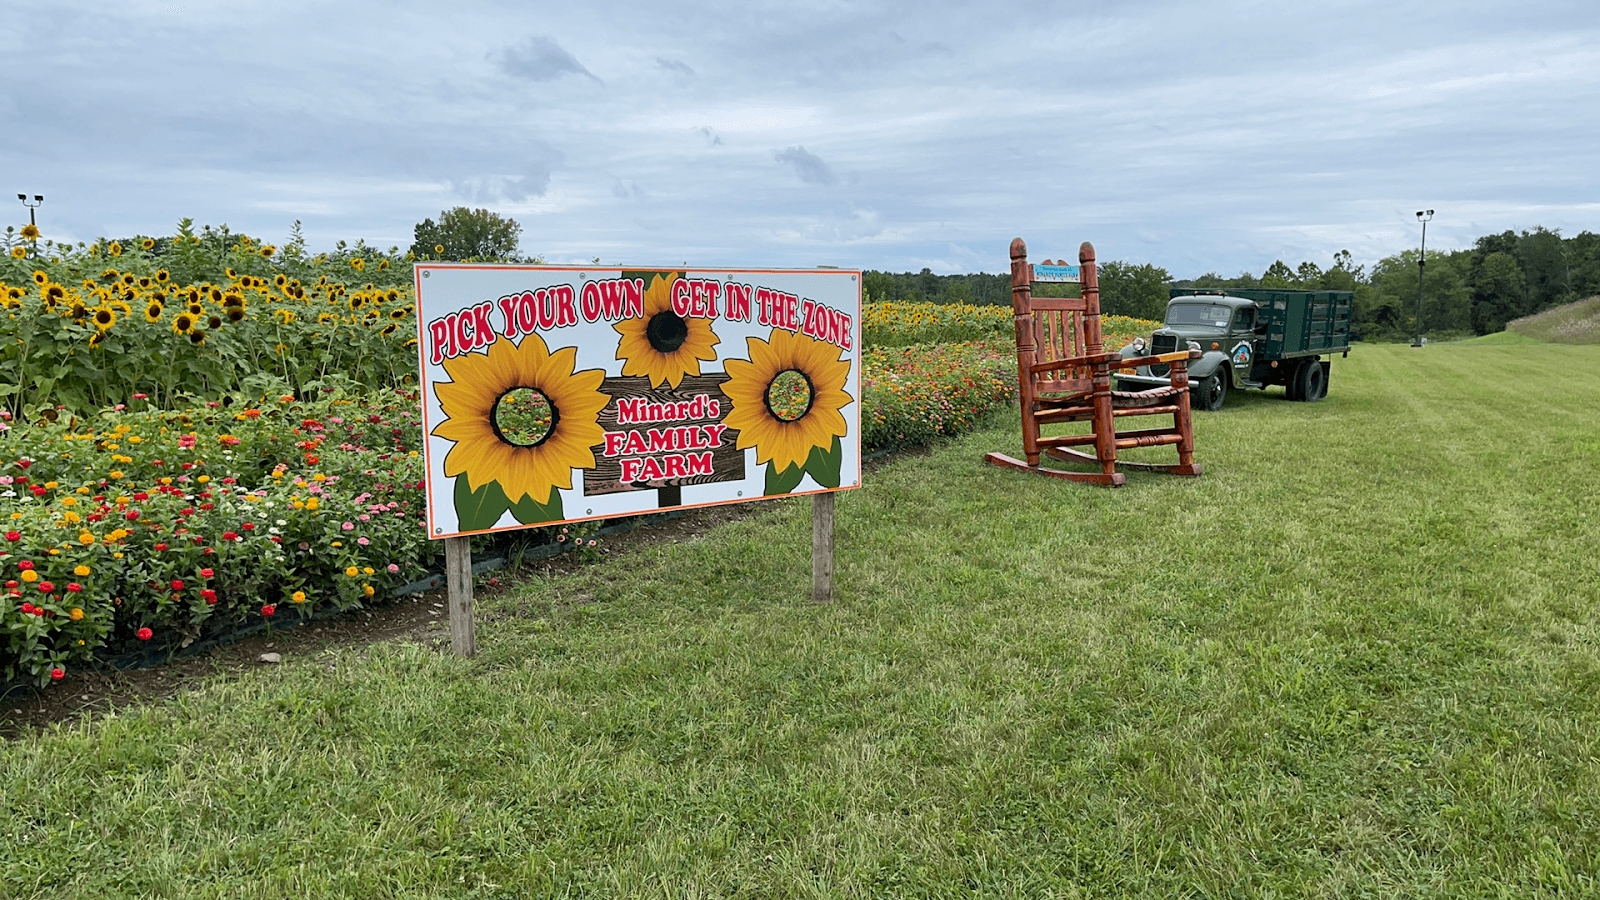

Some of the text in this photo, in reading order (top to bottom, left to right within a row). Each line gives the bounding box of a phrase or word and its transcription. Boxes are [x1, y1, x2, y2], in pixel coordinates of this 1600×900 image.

[429, 279, 644, 364] PICK YOUR OWN
[671, 279, 852, 351] GET IN THE ZONE
[617, 394, 719, 424] Minard's
[603, 424, 727, 456] FAMILY
[620, 452, 714, 483] FARM
